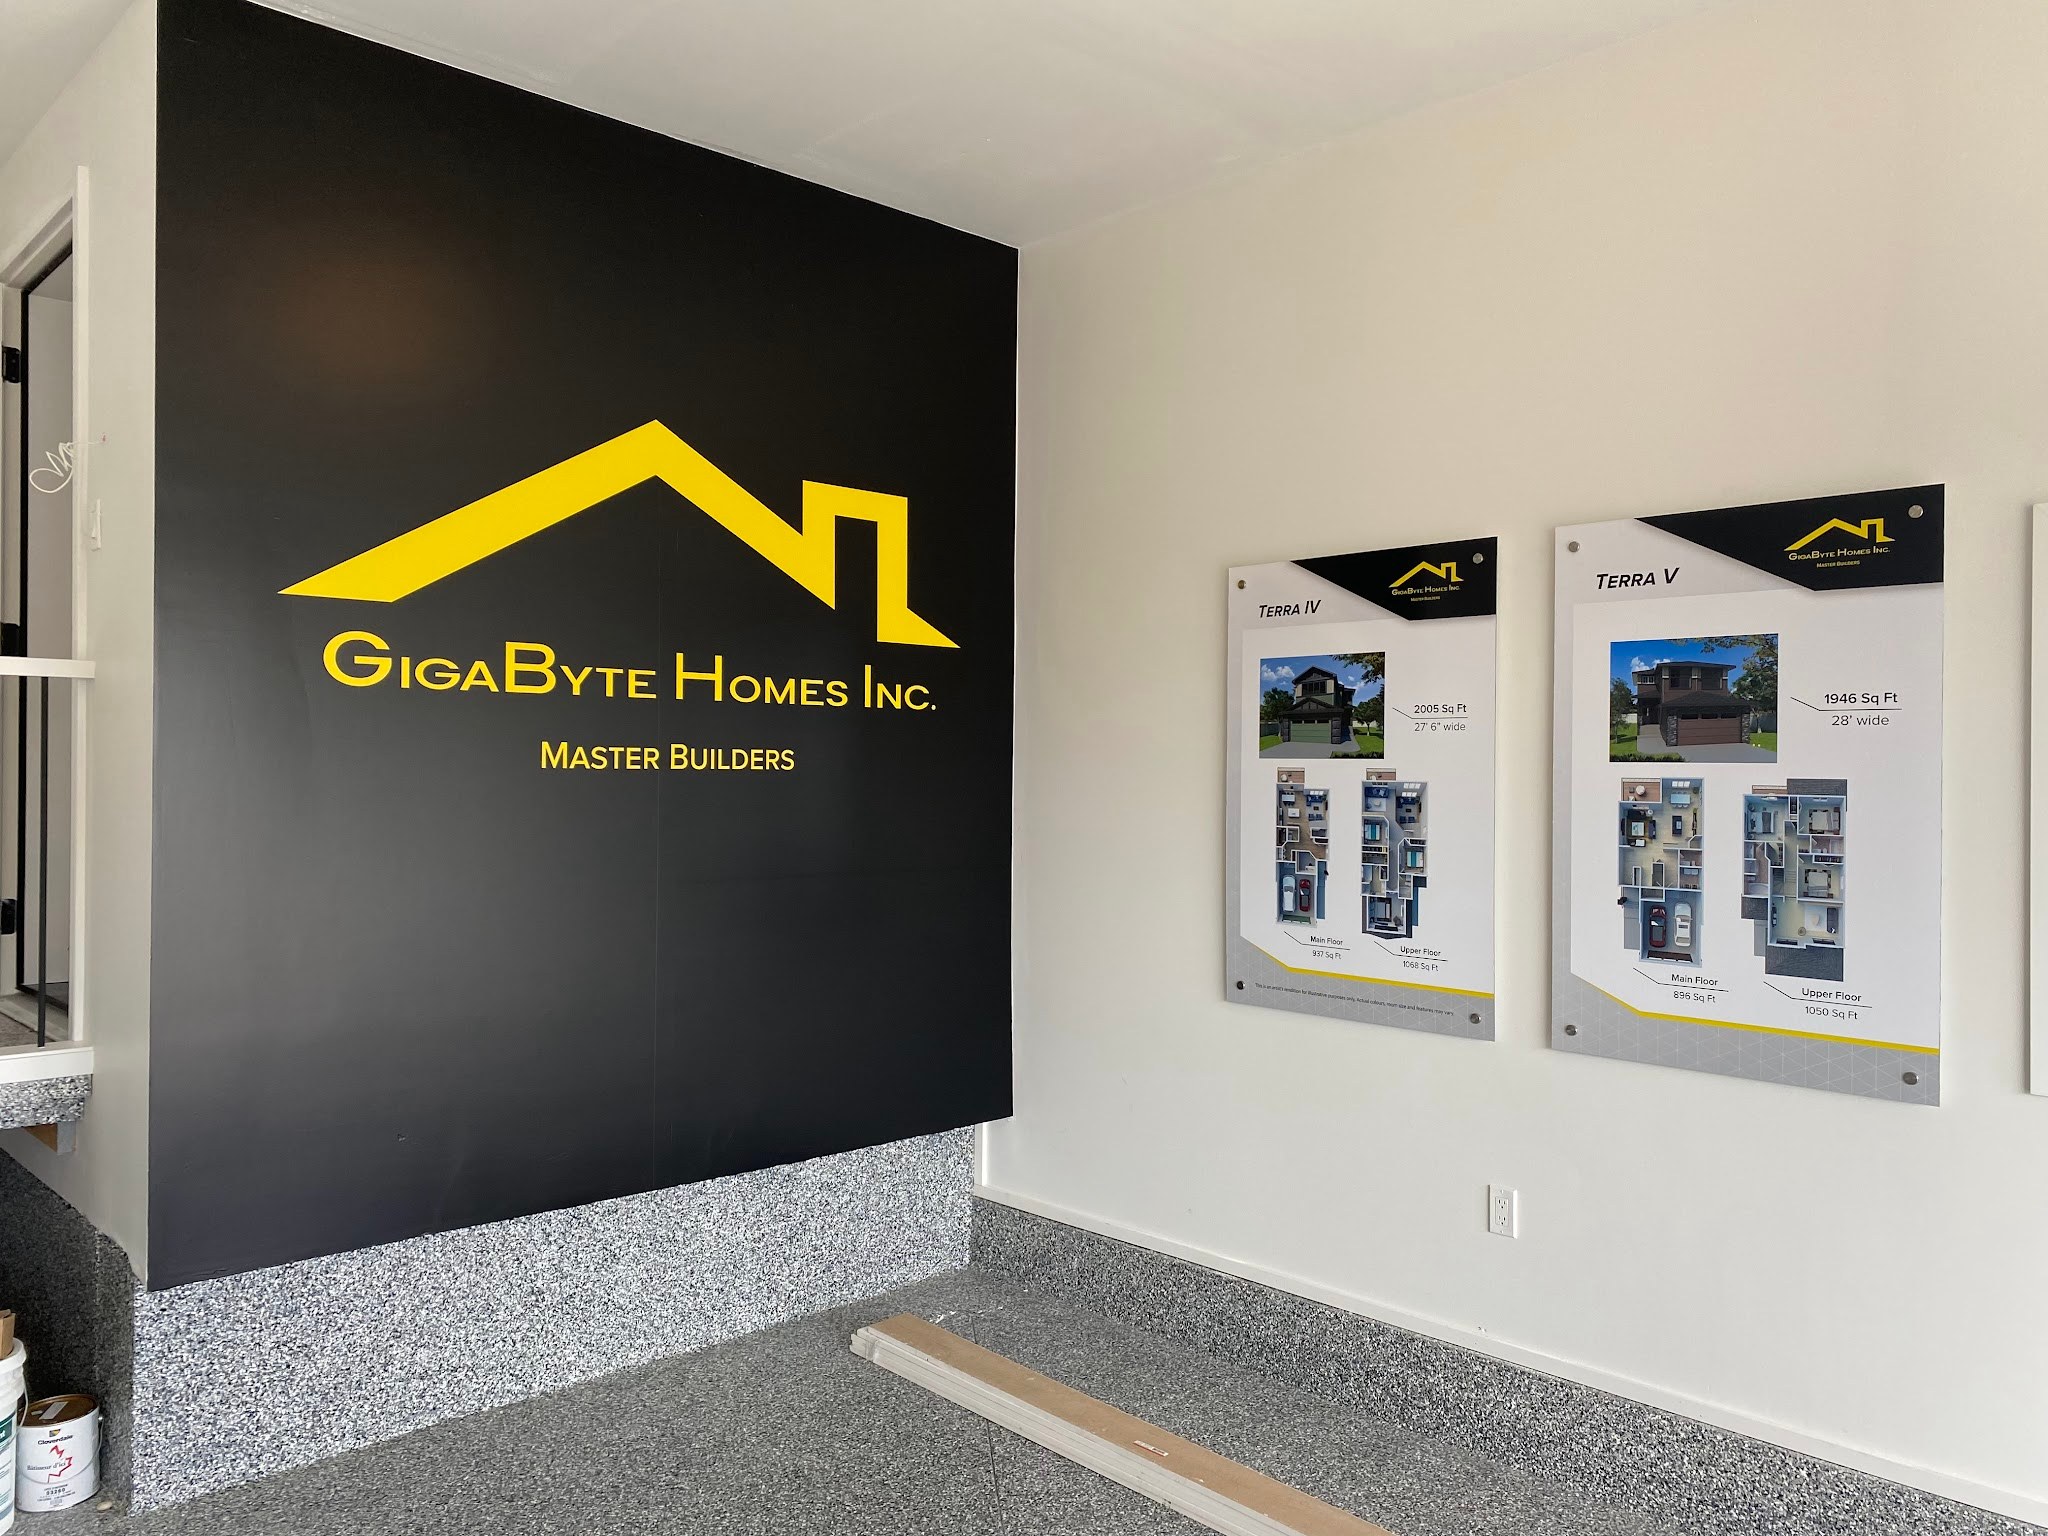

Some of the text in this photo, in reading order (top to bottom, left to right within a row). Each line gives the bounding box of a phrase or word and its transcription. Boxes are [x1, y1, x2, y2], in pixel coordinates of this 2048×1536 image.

[1596, 567, 1680, 590] Terra V
[1258, 599, 1321, 618] Terra IV
[1824, 691, 1898, 706] 1946 Sq Ft
[1414, 703, 1467, 715] 2005 Sq Ft
[1443, 721, 1466, 732] wide
[1856, 714, 1890, 727] wide
[540, 741, 795, 772] Master Builders
[1310, 935, 1344, 947] Main Floor
[1312, 950, 1342, 960] 937 Sq Ft
[1400, 946, 1441, 958] Upper Floor
[1420, 962, 1430, 972] Sq
[1431, 963, 1439, 972] Ft
[1671, 973, 1719, 987] Main Floor
[1673, 990, 1716, 1004] 896 Sq Ft
[1801, 987, 1862, 1002] Upper Floor
[1805, 1006, 1858, 1020] 1050 Sq Ft
